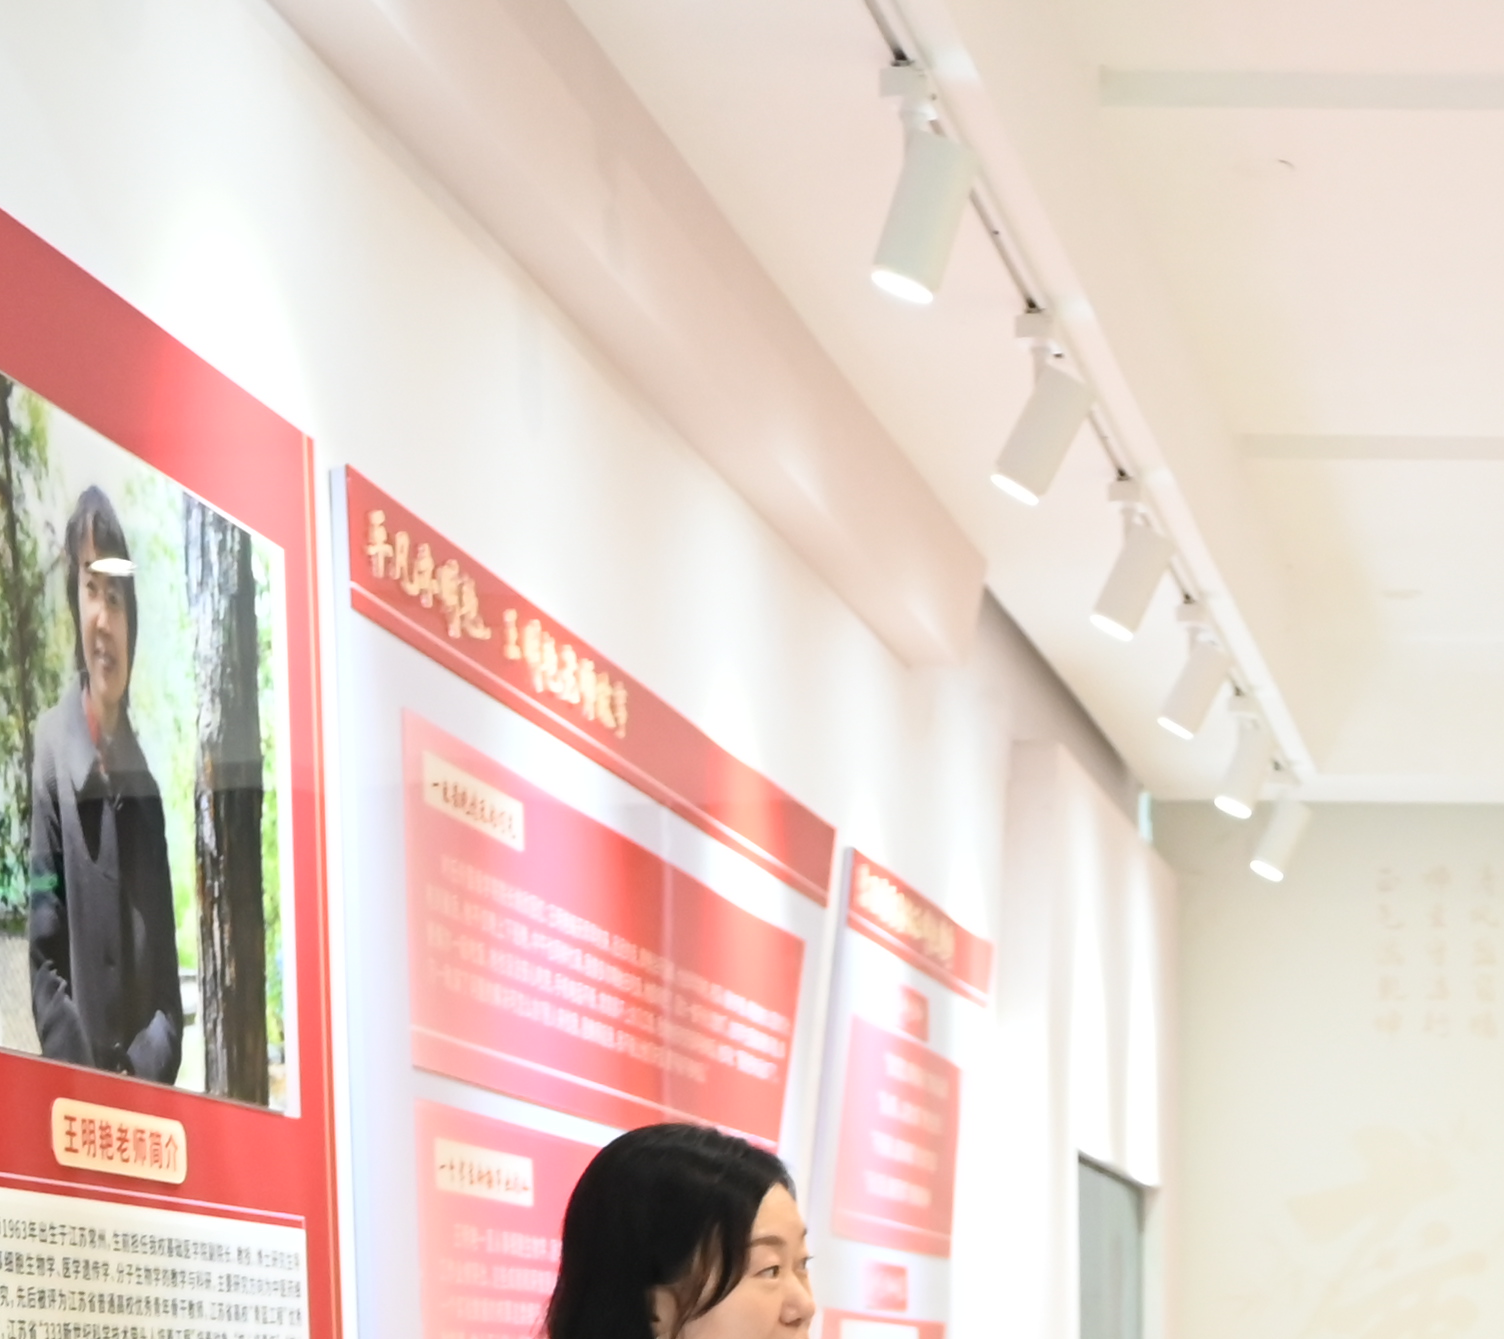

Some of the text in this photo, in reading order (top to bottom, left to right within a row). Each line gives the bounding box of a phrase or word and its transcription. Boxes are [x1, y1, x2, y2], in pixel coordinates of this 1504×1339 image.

[62, 1113, 179, 1173] 王明艳老师简介
